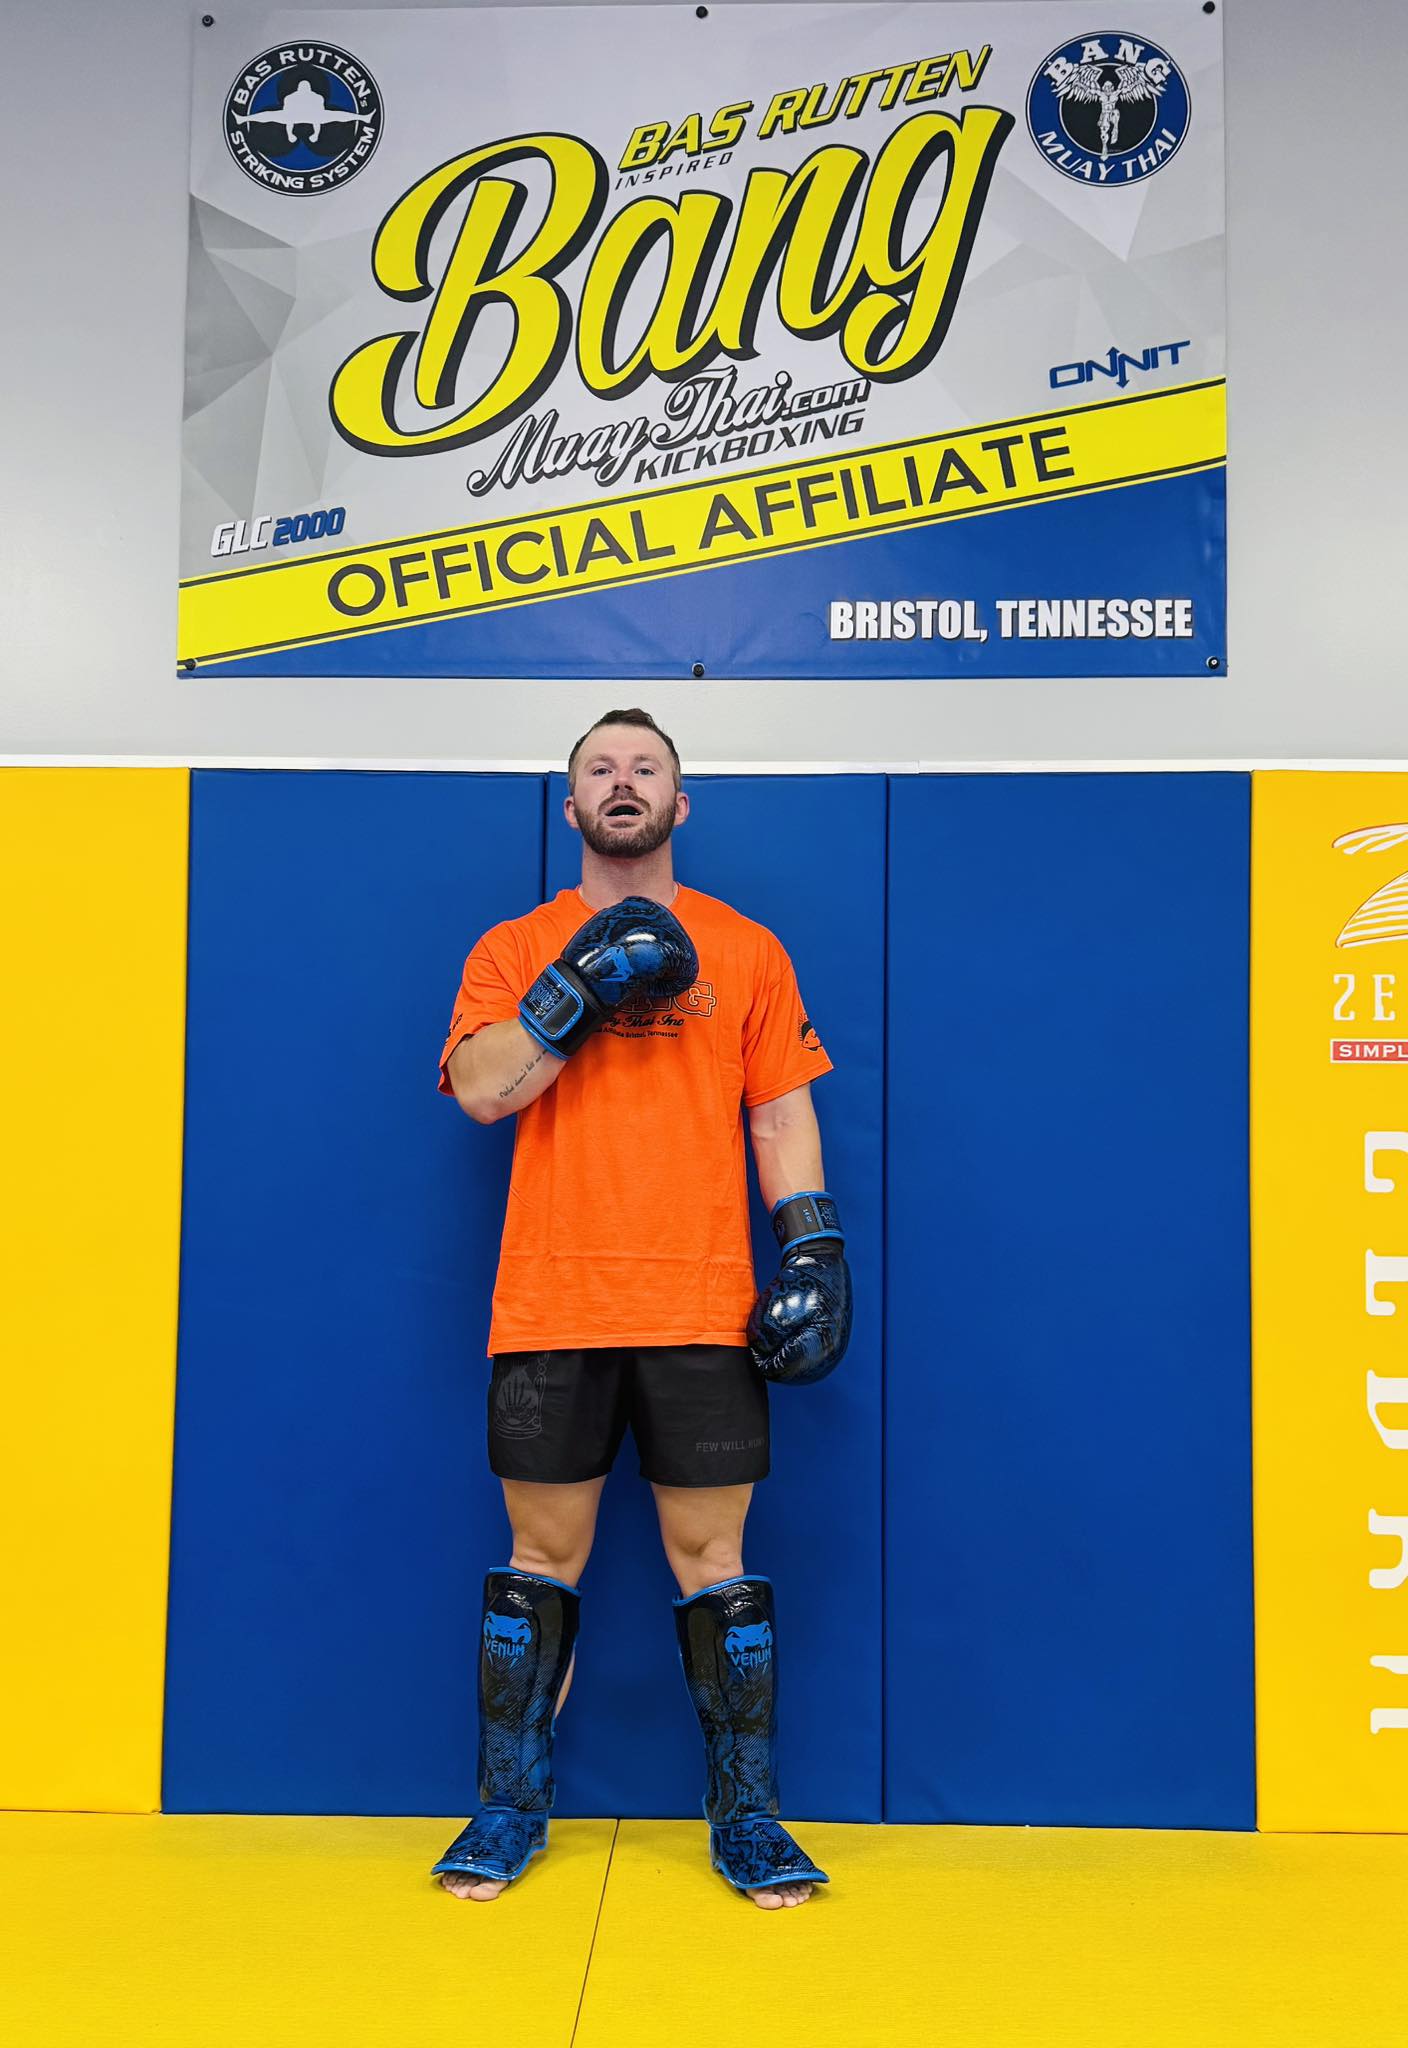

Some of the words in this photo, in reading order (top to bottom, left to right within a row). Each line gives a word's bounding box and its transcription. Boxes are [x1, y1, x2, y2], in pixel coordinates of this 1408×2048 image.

[234, 60, 272, 105] BAS
[1043, 38, 1172, 88] BANG
[617, 100, 753, 173] BAS
[757, 44, 993, 141] RUTTEN
[230, 130, 305, 189] STRIKING
[310, 126, 376, 188] SYSTEM
[615, 151, 734, 190] INSPIRED
[1037, 130, 1115, 181] MUAY
[1121, 127, 1177, 178] THAI
[329, 105, 1016, 458] Bang
[1049, 339, 1191, 389] ONNIT
[466, 408, 653, 497] Muay
[633, 408, 866, 484] KICKBOXING
[210, 515, 272, 557] GLC
[272, 506, 346, 547] 2000
[327, 510, 676, 617] OFFICIAL
[698, 426, 1075, 550] AFFILIATE
[830, 600, 988, 642] BRISTOL,
[996, 598, 1194, 640] TENNESSEE
[695, 1441, 719, 1453] FEW
[720, 1439, 745, 1451] WILL
[484, 1637, 526, 1659] VENUM
[730, 1646, 772, 1668] VENUM
